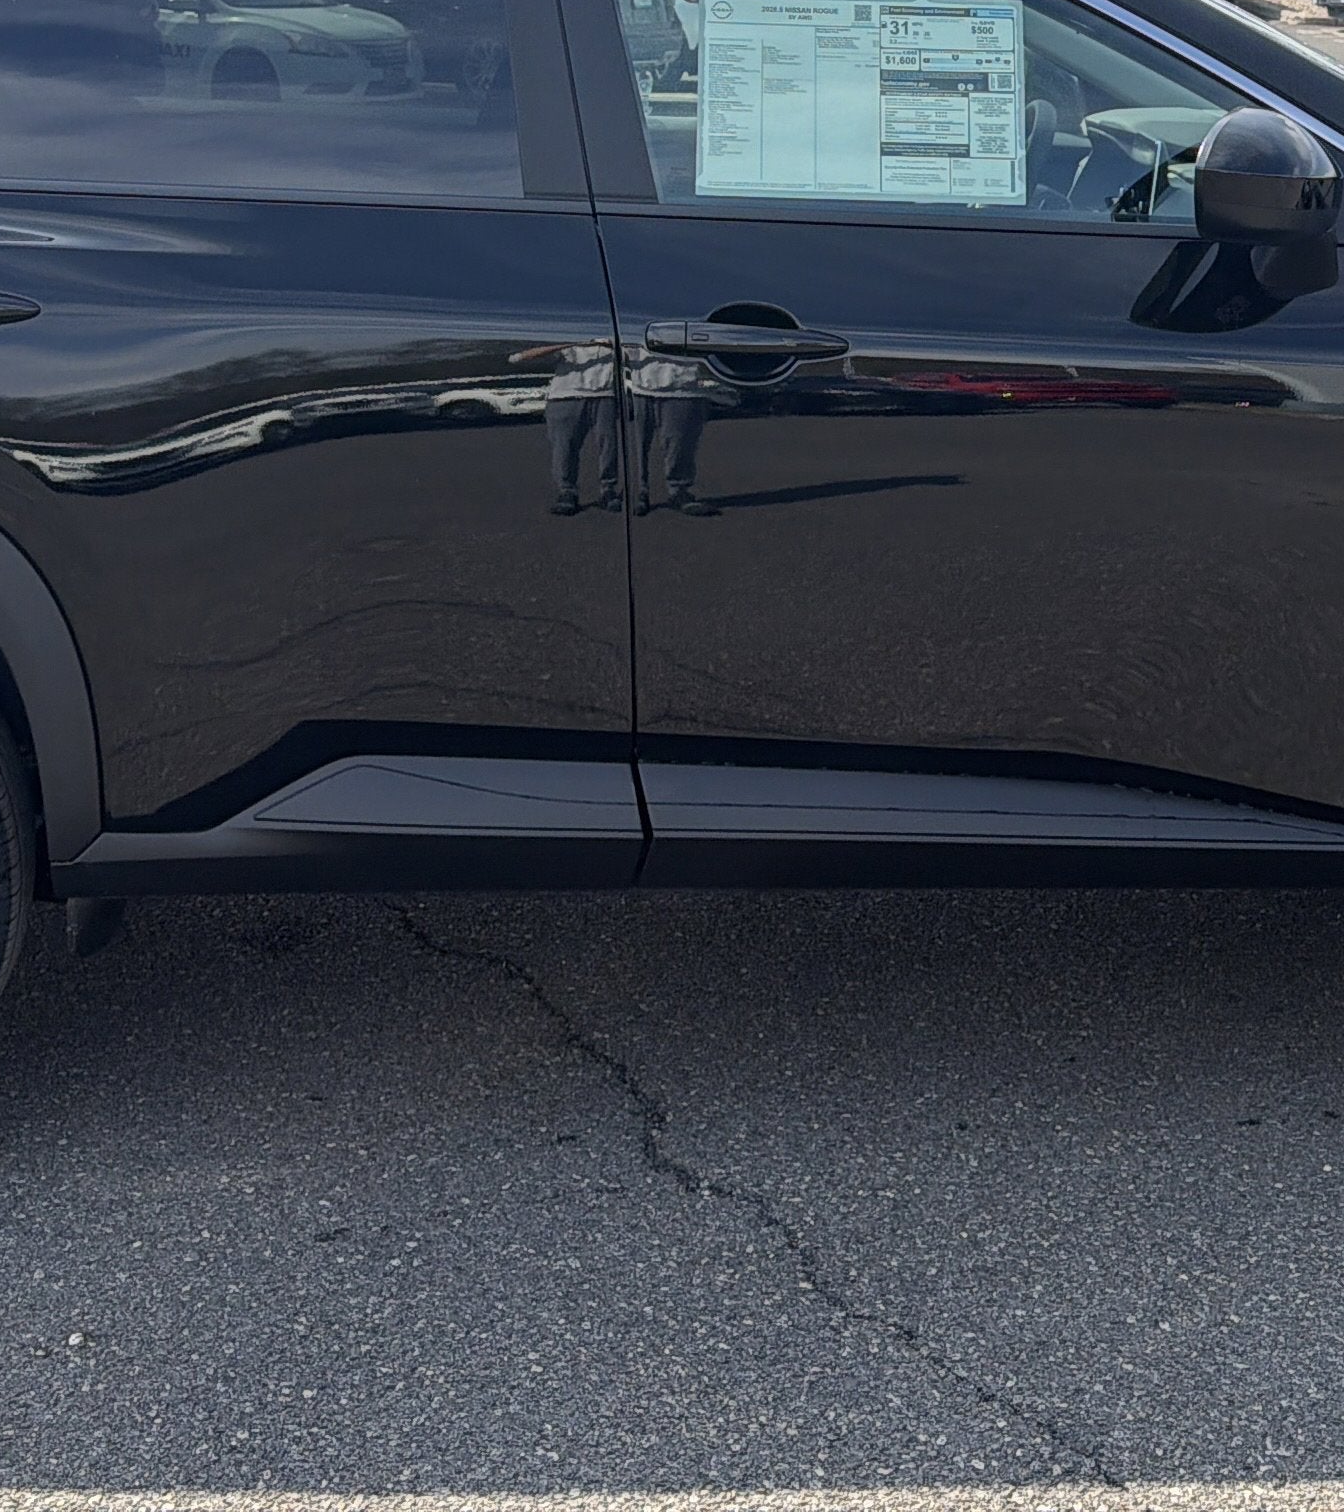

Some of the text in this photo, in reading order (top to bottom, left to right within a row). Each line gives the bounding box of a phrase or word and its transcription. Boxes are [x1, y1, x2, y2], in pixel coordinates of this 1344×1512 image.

[784, 6, 812, 14] NISSAN
[813, 7, 839, 15] ROGUE
[889, 20, 909, 35] 31
[971, 25, 994, 34] $500
[885, 55, 917, 66] $1,600
